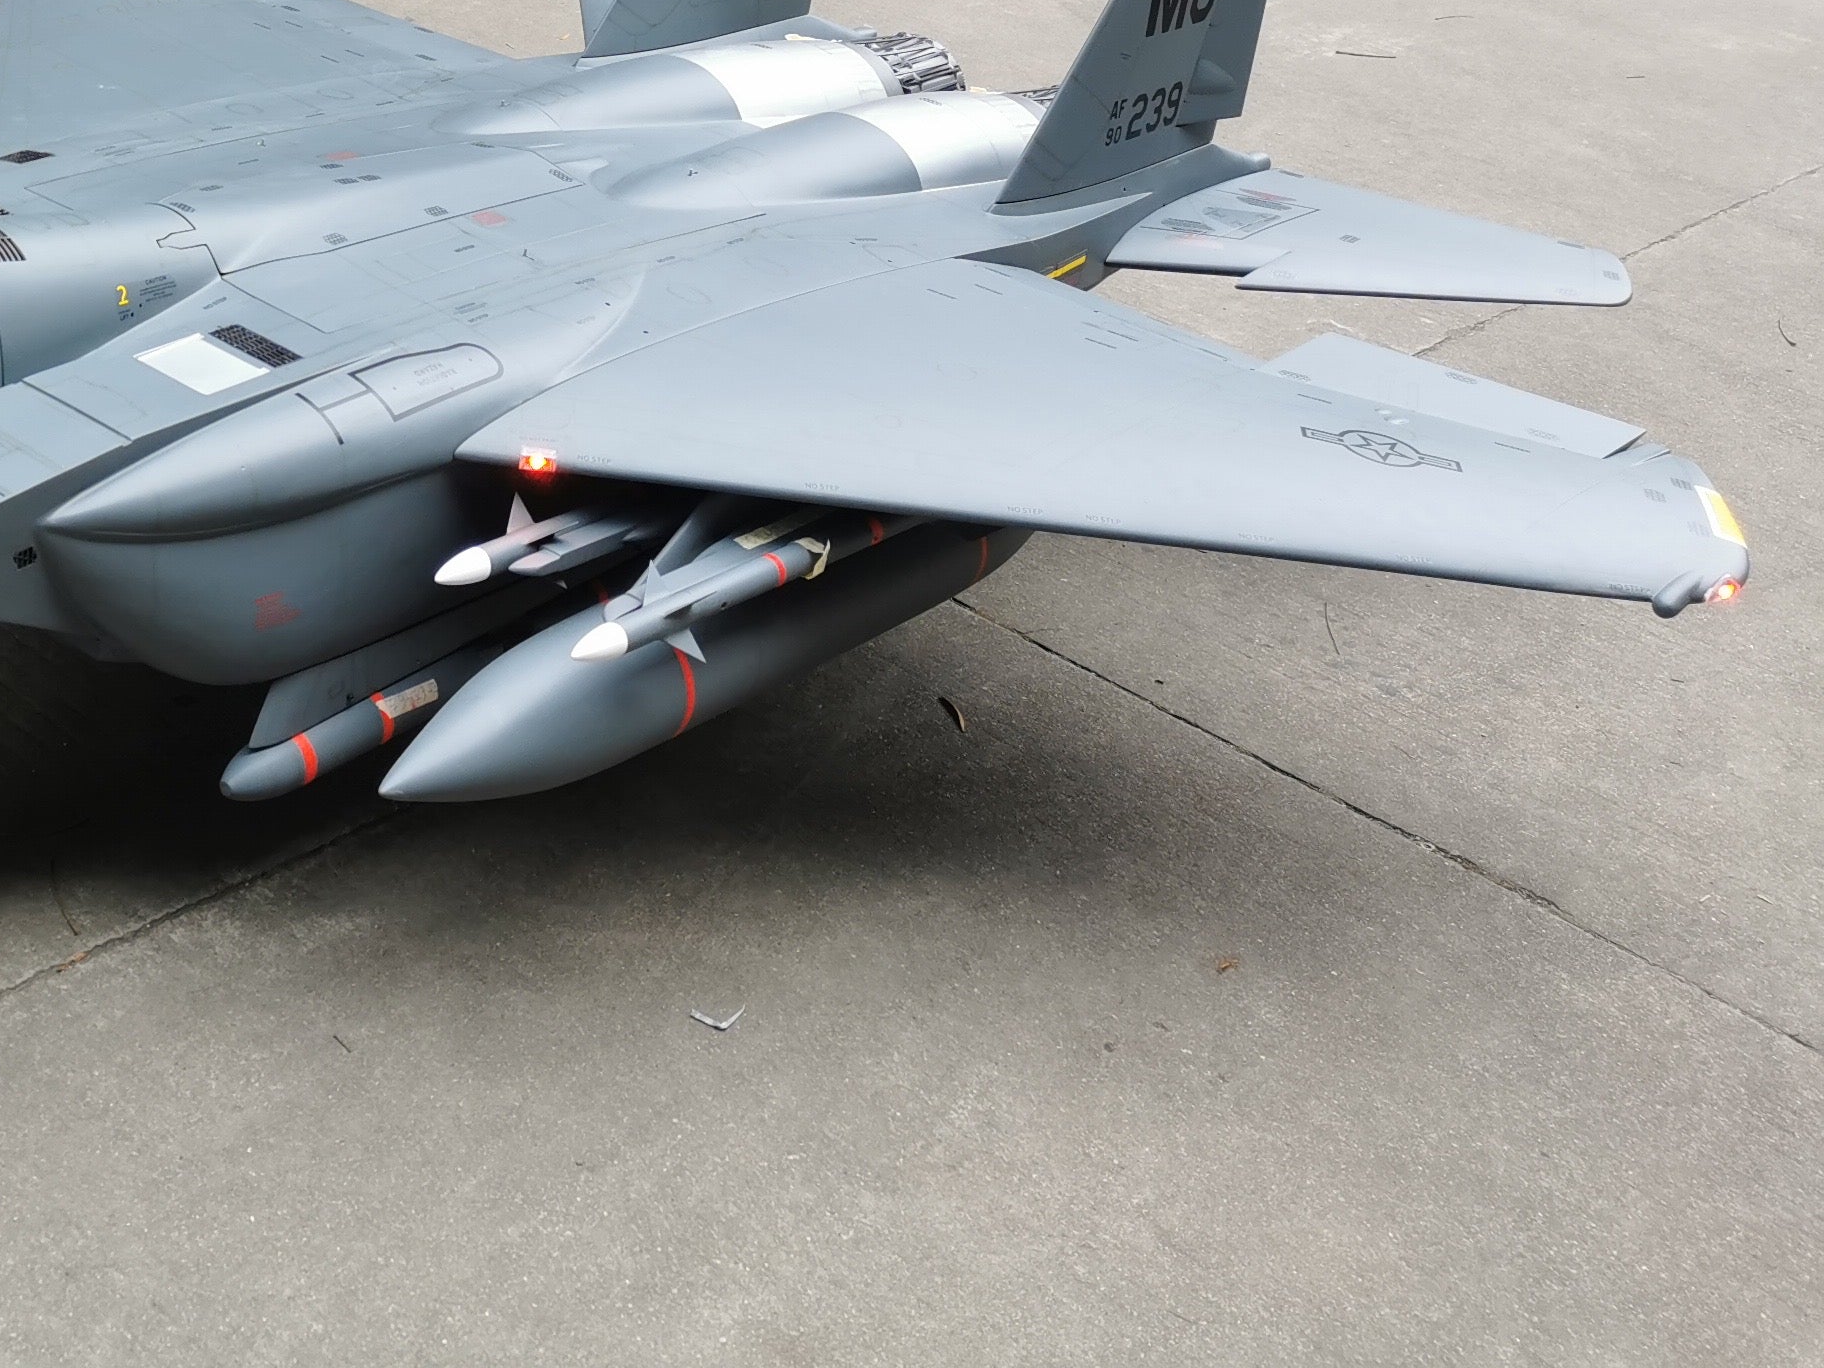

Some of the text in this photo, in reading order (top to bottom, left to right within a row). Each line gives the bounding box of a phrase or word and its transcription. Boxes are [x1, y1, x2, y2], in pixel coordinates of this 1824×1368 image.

[1109, 98, 1129, 121] AF
[1125, 80, 1184, 141] 239
[116, 284, 130, 307] 2
